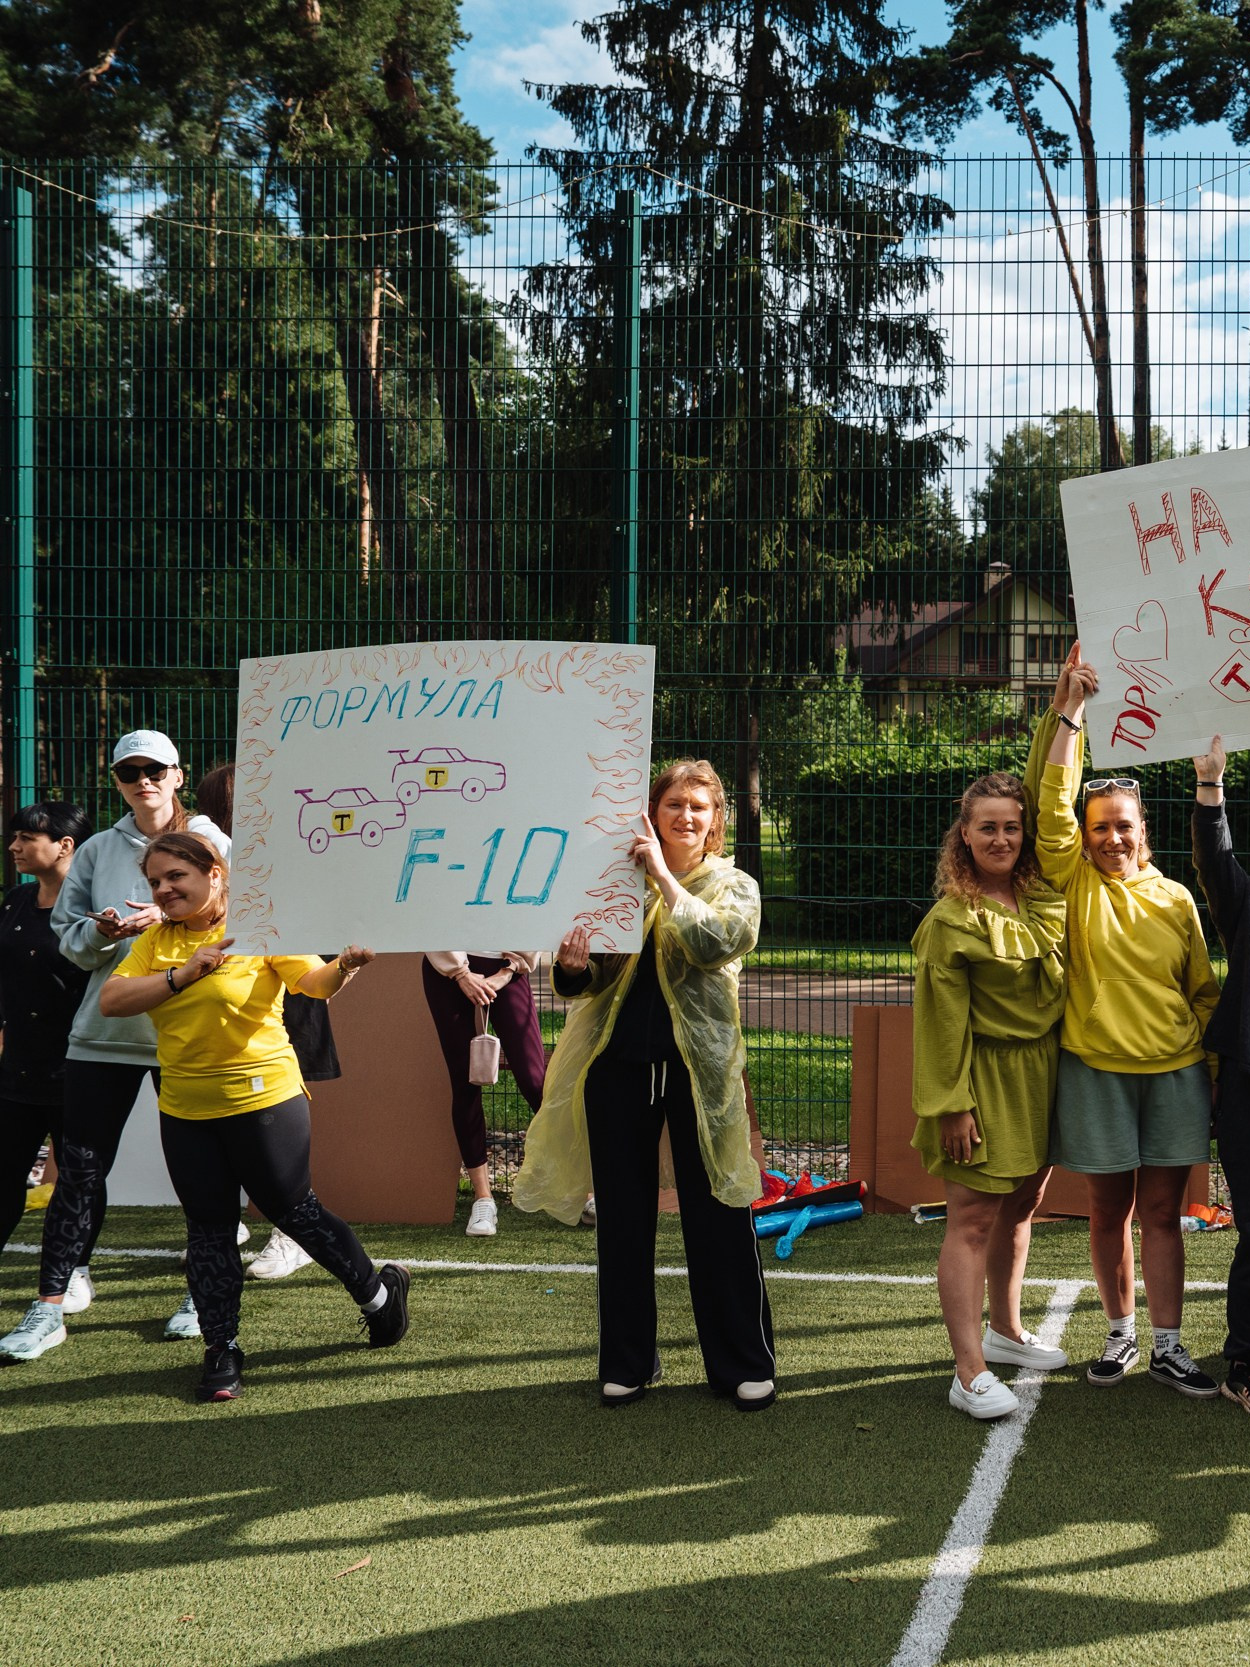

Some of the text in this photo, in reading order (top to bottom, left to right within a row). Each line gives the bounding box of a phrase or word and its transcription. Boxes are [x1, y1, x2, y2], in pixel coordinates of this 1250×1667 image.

[1128, 487, 1233, 576] НА
[280, 677, 503, 742] ФОРМУЛА
[395, 827, 569, 906] F-10
